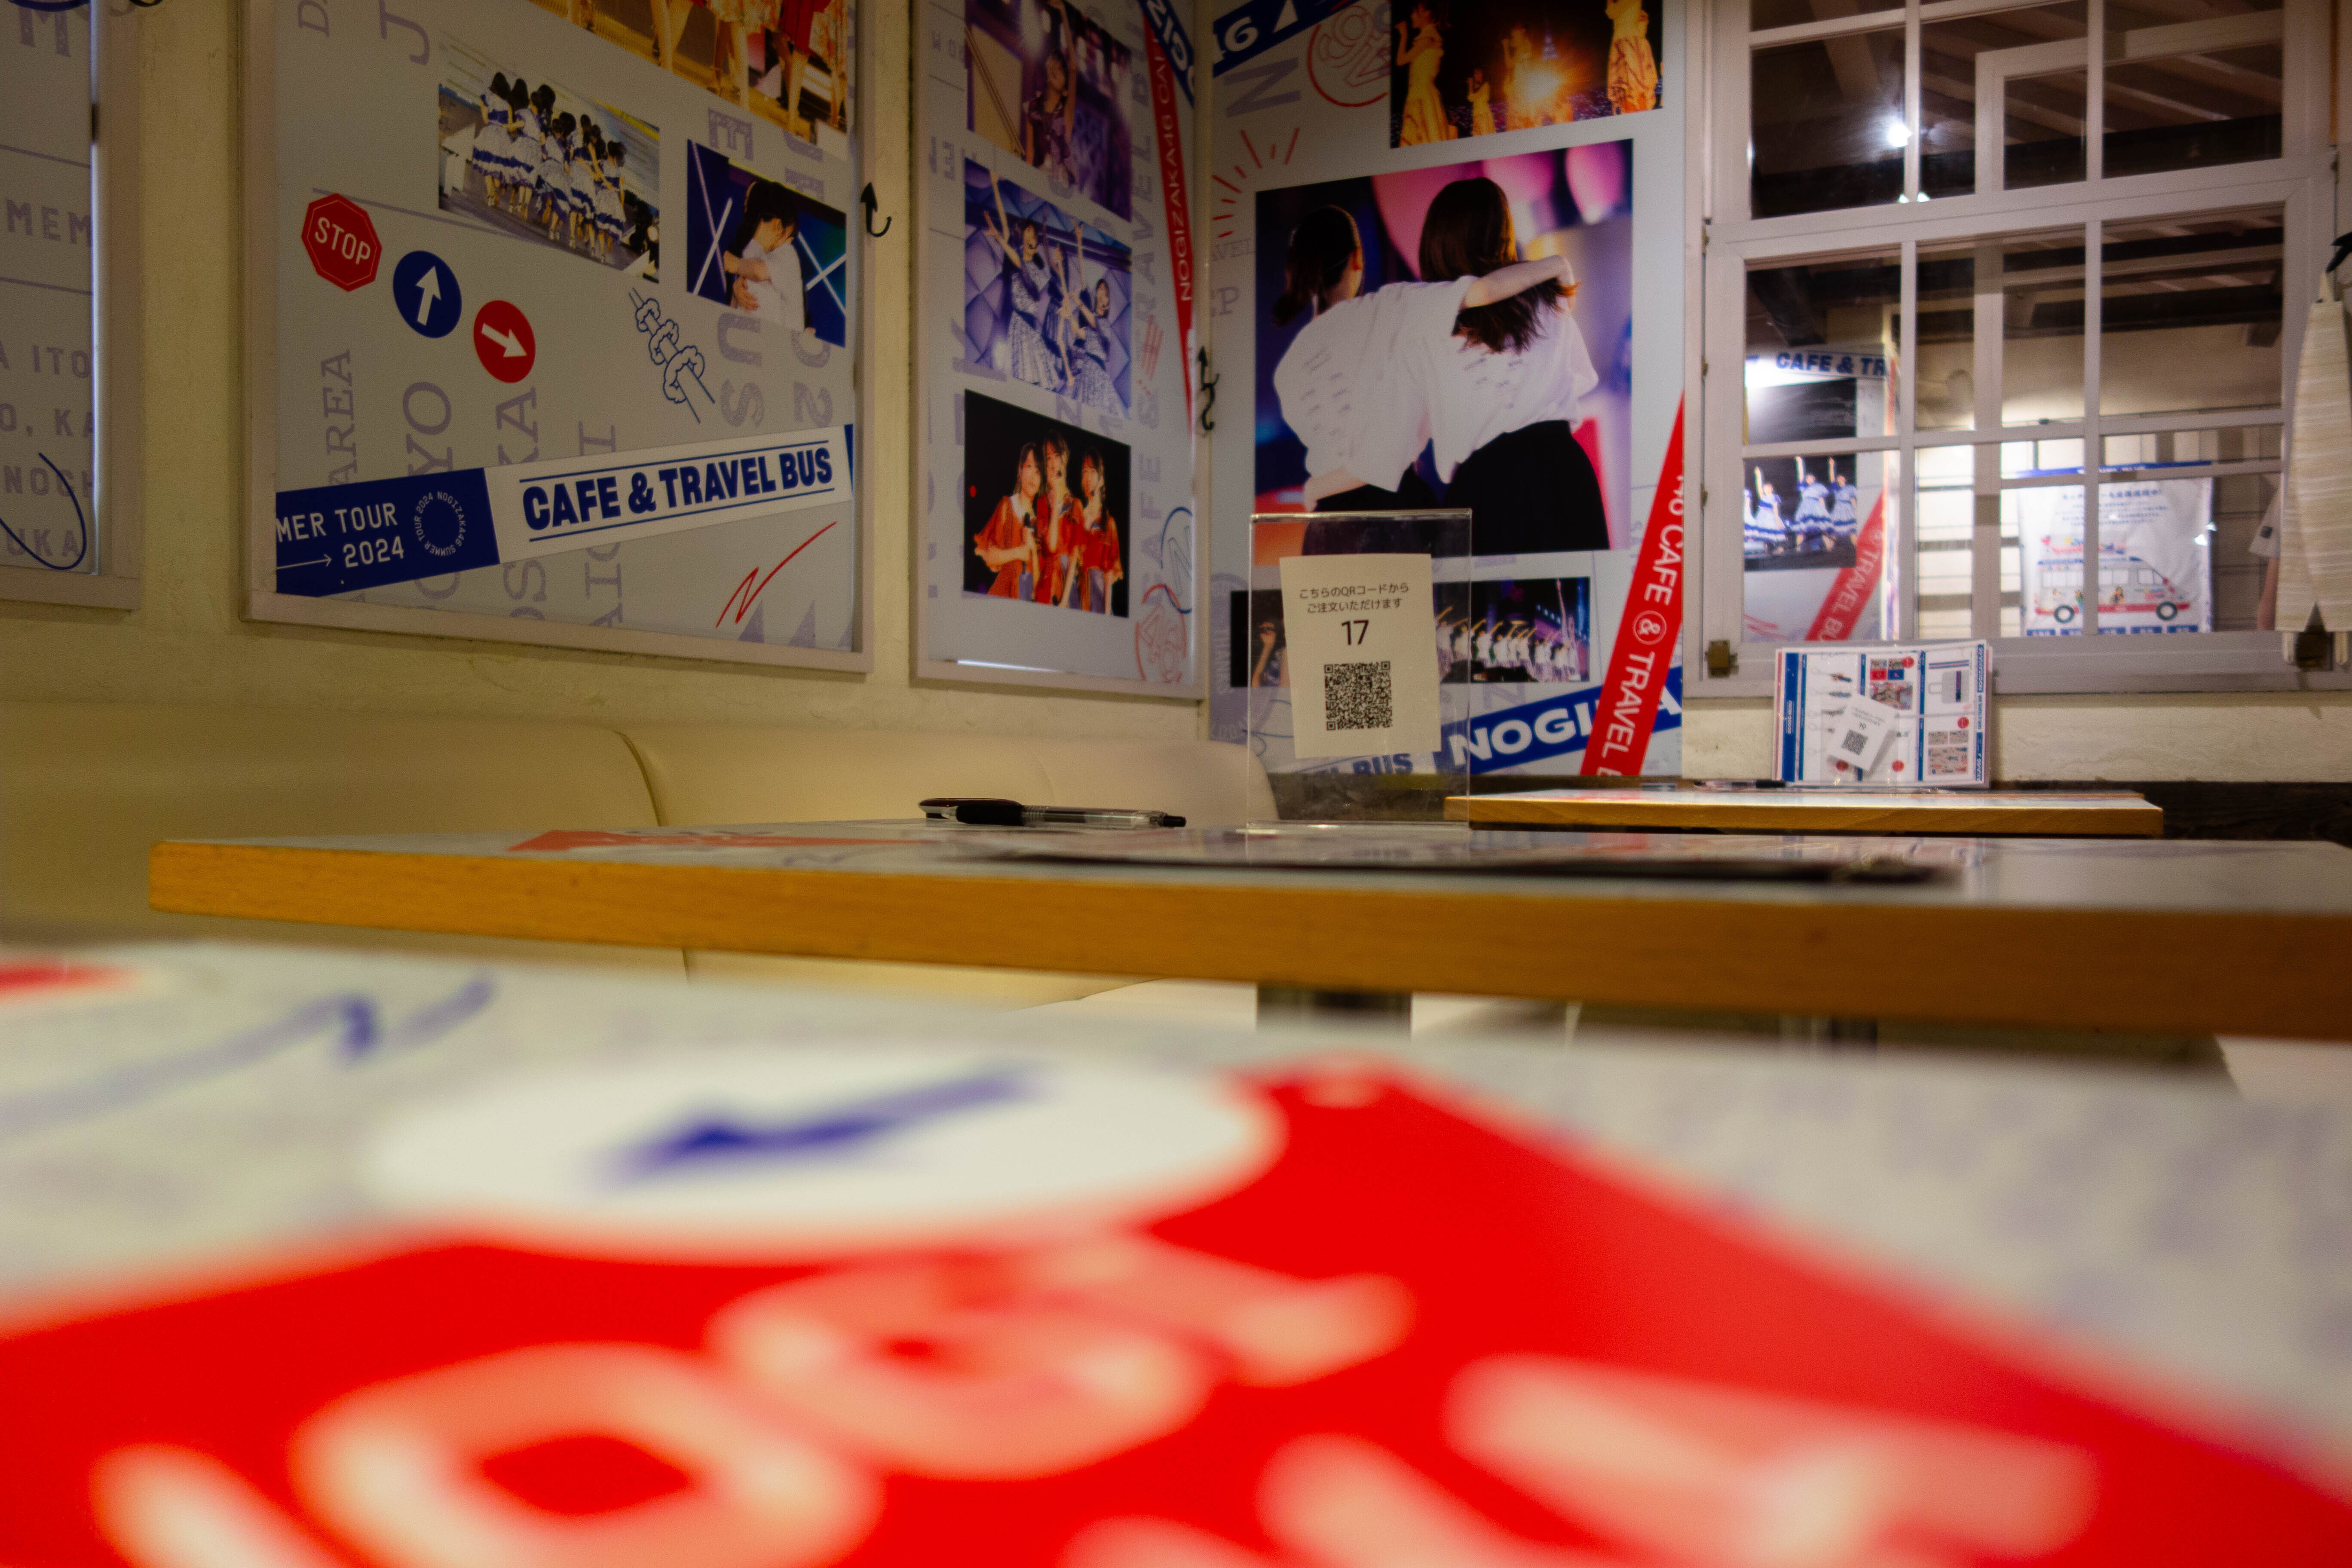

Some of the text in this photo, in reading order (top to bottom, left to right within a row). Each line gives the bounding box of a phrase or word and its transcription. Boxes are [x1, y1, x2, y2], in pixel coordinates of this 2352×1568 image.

[314, 215, 371, 265] STOP
[1776, 352, 1832, 373] CAFE
[1836, 355, 1855, 374] &
[522, 447, 833, 531] CAFE & TRAVEL BUS
[335, 502, 398, 534] TOUR
[414, 491, 466, 557] NOGIZAKA46 SUMMER TOUR 2024
[343, 536, 405, 569] 2024
[1644, 524, 1684, 606] CAFE
[1299, 583, 1409, 599] こちらのQRコードから
[1308, 597, 1403, 614] ご注文いただけます
[1341, 619, 1369, 646] 17
[1601, 651, 1656, 759] TRAVEL
